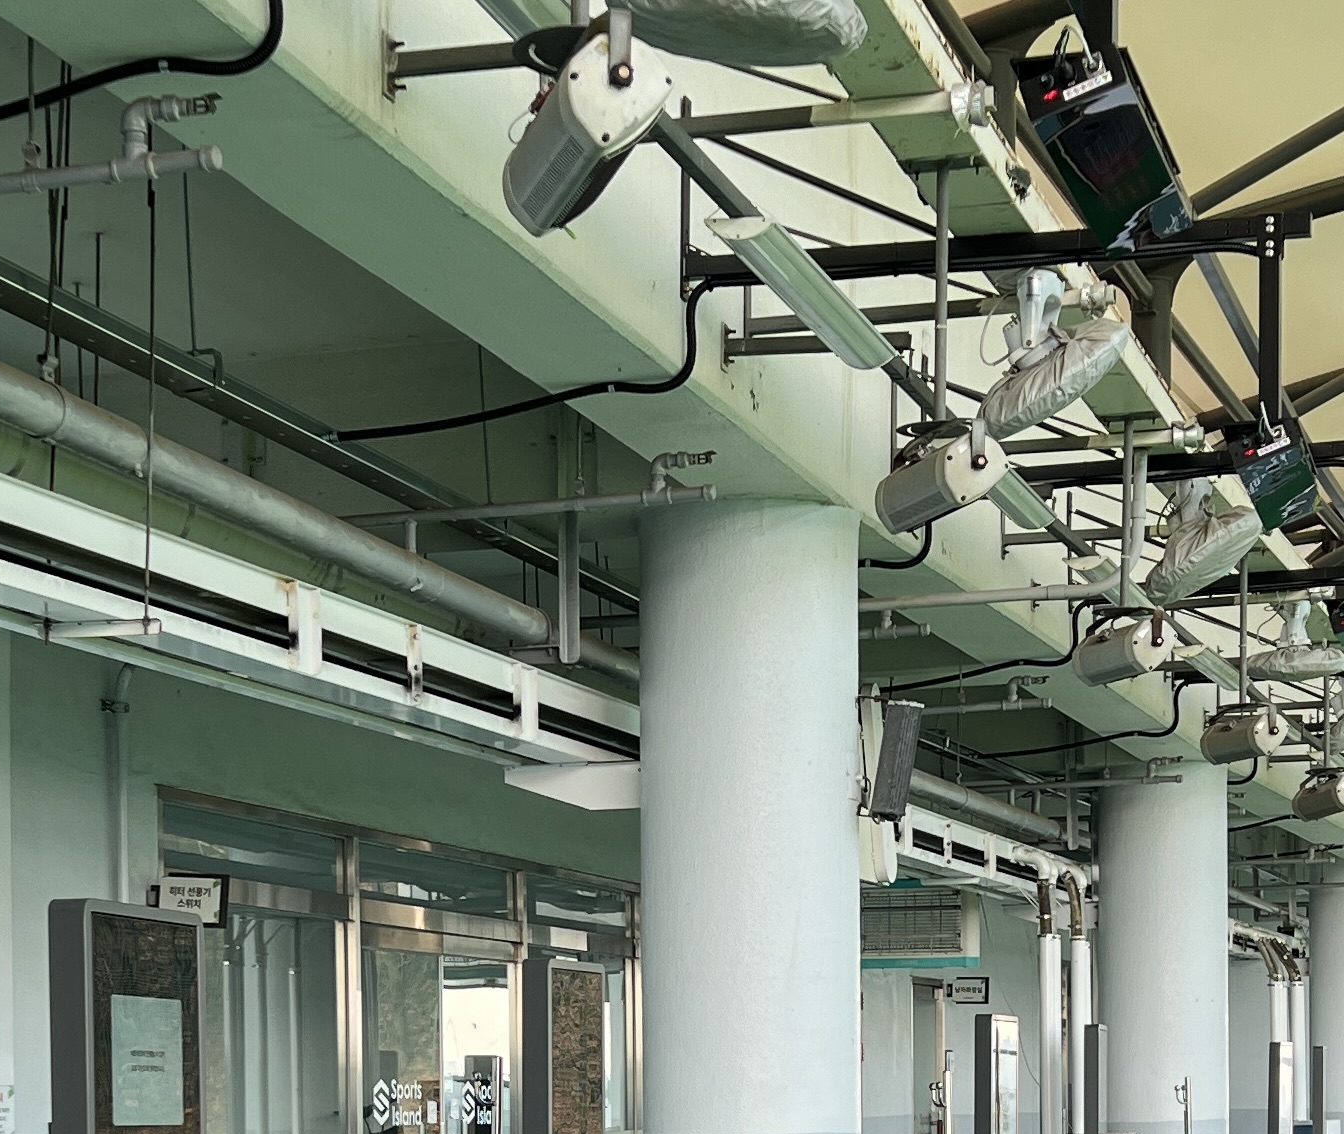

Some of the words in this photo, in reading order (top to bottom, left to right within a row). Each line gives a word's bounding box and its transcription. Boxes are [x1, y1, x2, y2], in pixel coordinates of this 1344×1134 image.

[169, 886, 185, 897] 히터
[187, 887, 211, 898] 선풍기
[177, 898, 202, 909] 스위치
[390, 1078, 423, 1102] Sports
[391, 1105, 423, 1127] Island
[476, 1106, 493, 1126] Isla
